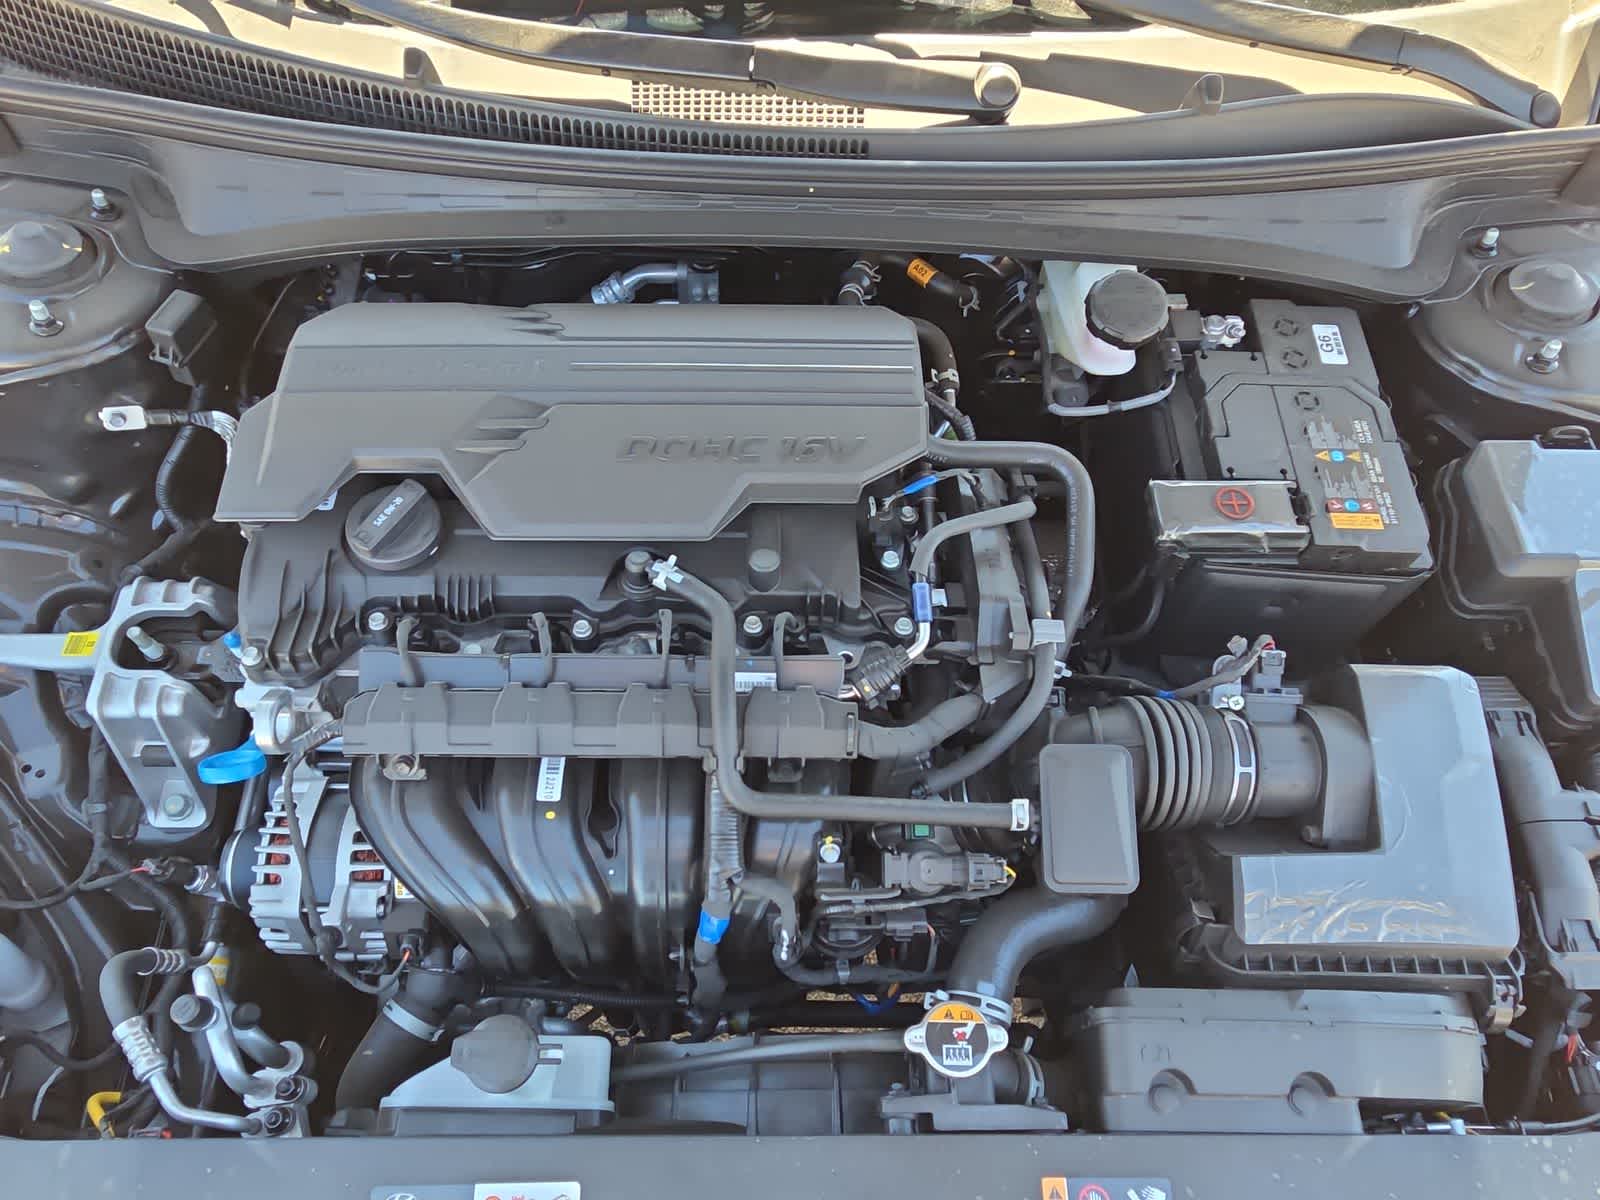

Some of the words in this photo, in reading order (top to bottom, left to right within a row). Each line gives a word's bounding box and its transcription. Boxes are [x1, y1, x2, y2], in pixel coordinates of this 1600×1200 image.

[1318, 335, 1334, 352] G6
[615, 434, 769, 464] DOHC
[774, 435, 868, 464] 16V
[373, 512, 388, 527] SAE
[384, 496, 404, 515] 0W-20
